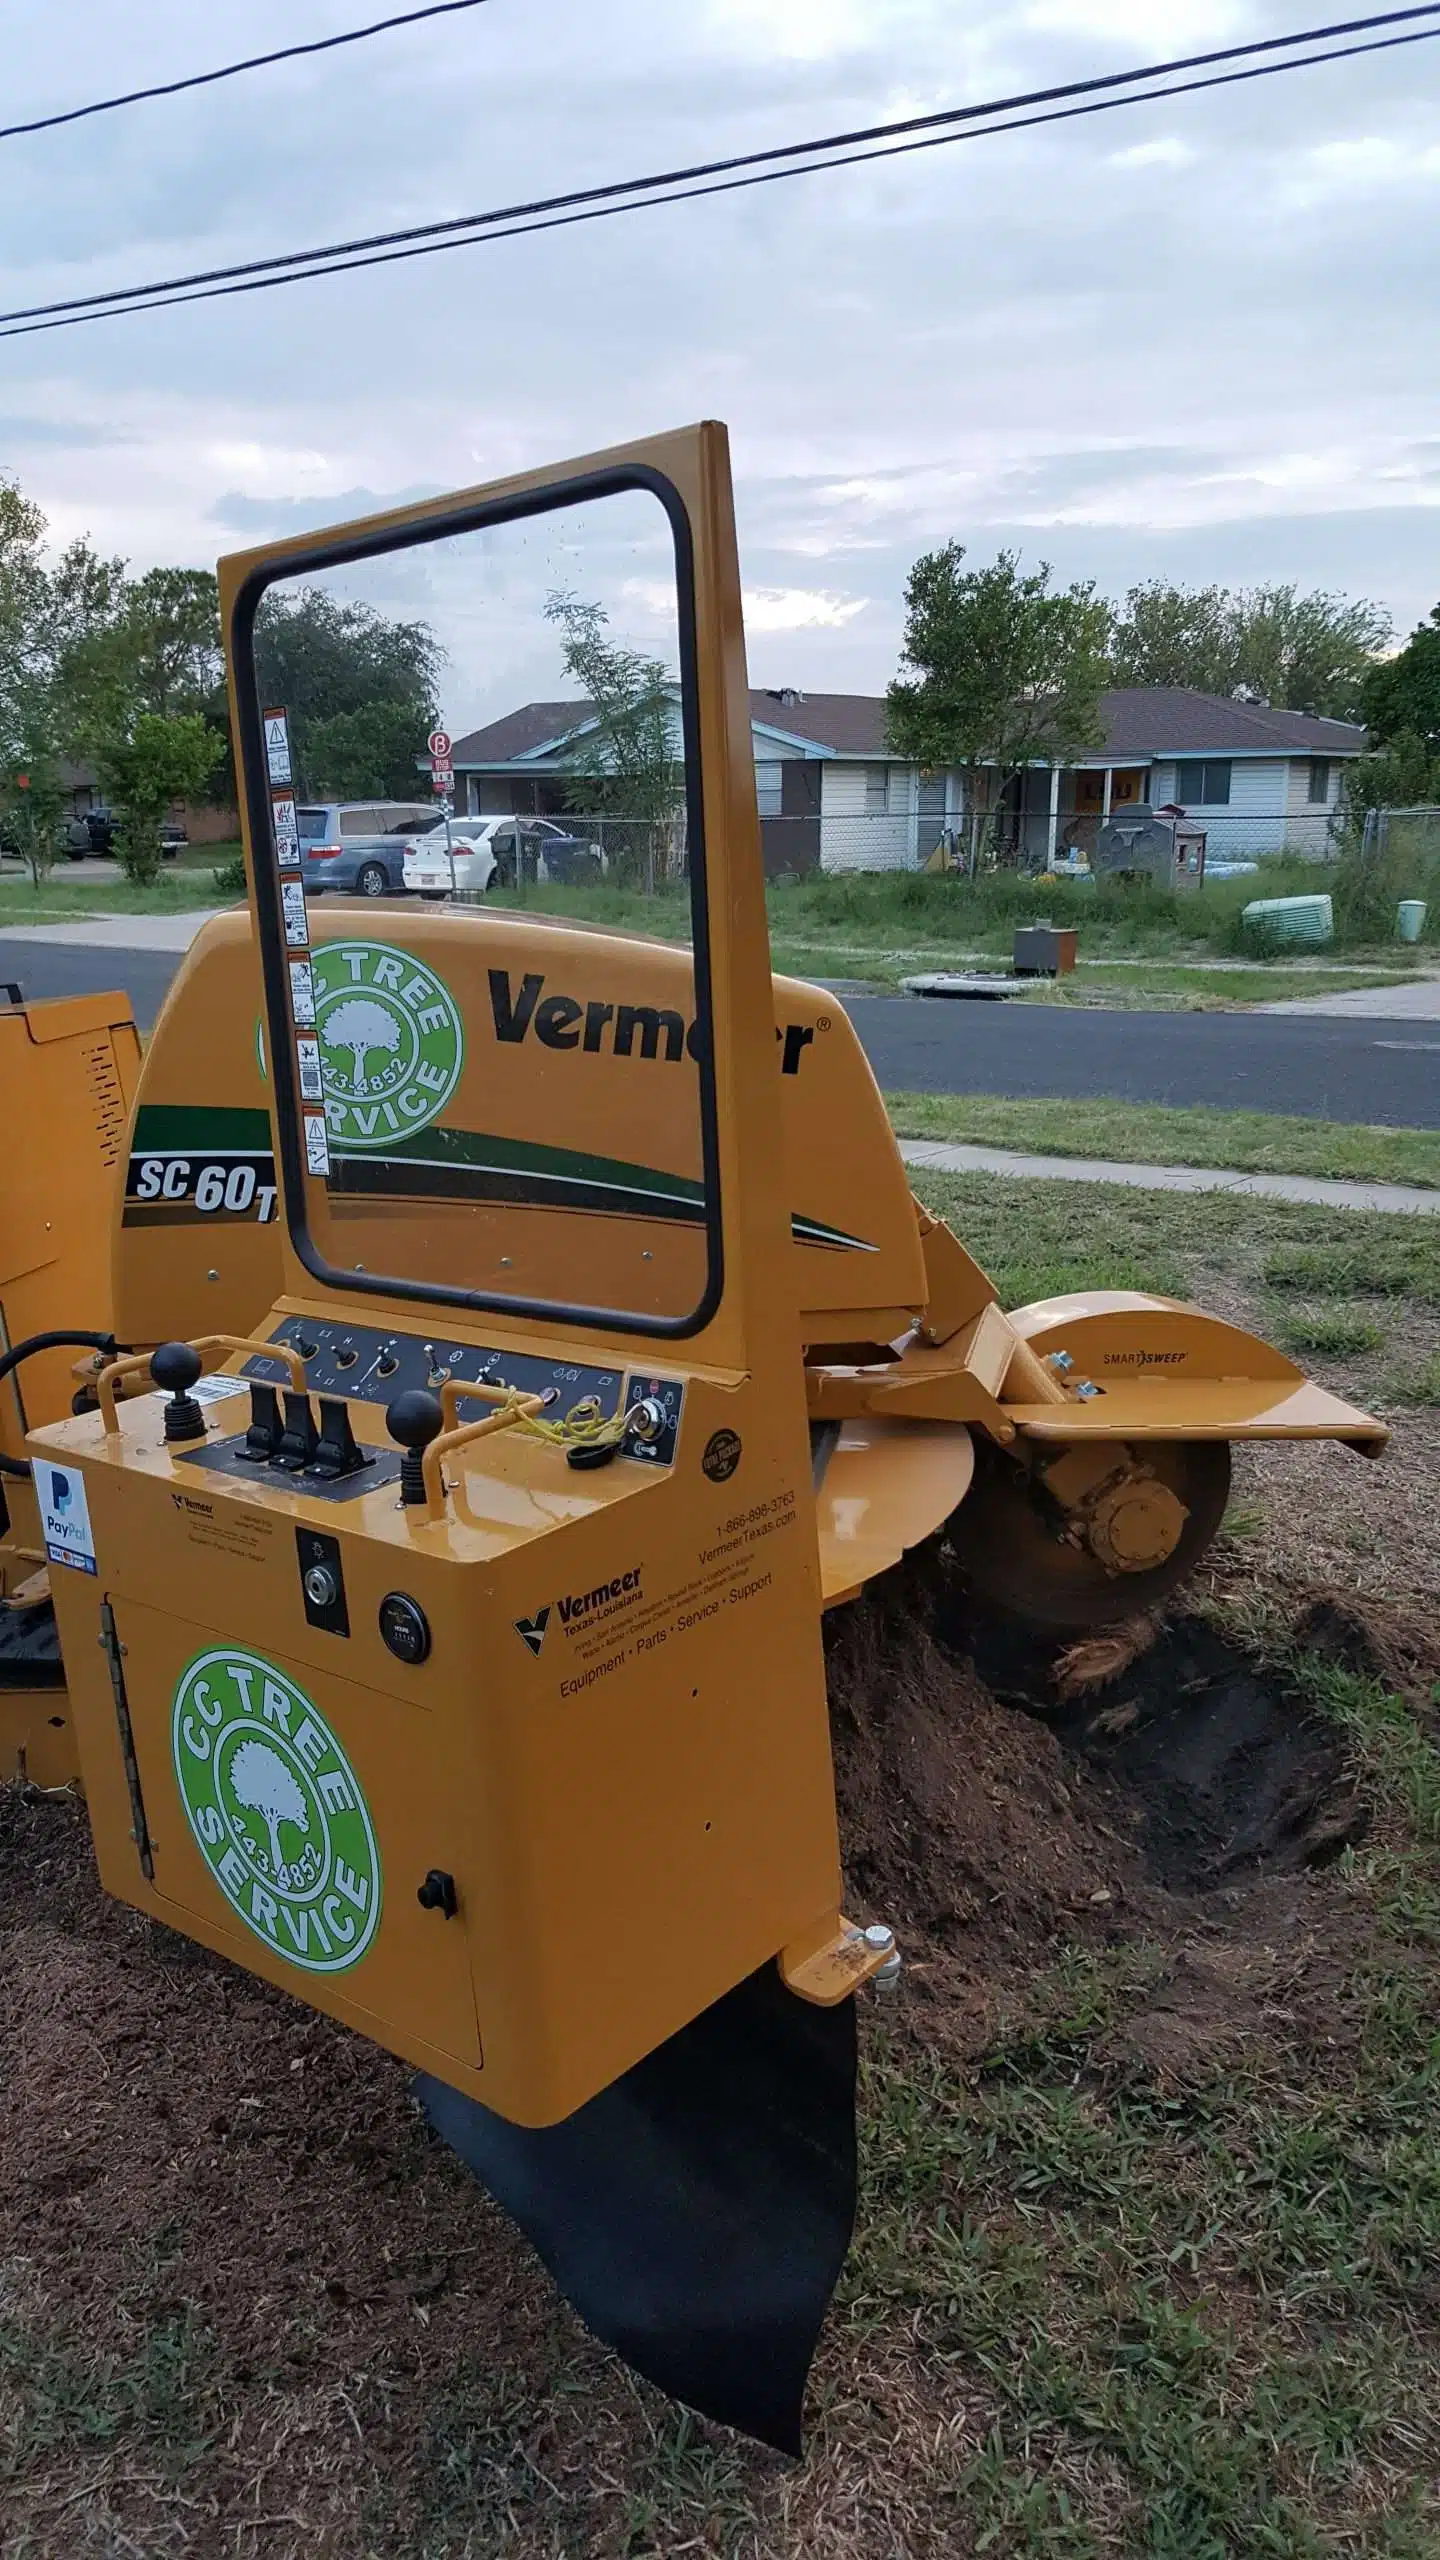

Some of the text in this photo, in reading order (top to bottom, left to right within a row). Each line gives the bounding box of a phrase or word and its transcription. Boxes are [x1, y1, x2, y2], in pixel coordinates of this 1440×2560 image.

[1084, 783, 1132, 799] LU
[341, 952, 451, 1035] TREE
[323, 1060, 449, 1136] RVICE
[47, 1515, 86, 1541] PayPal
[698, 1510, 796, 1565] VermeerTexas.com
[556, 1566, 642, 1624] Vermeer
[563, 1589, 644, 1638] Texas-Louisiana
[560, 1650, 625, 1698] Equipment
[636, 1629, 667, 1656] Parts
[677, 1600, 720, 1632] Service
[729, 1571, 773, 1604] Support
[183, 1665, 355, 1816] CC TREE
[196, 1805, 368, 1955] SERVICE
[230, 1812, 322, 1891] 443-4852
